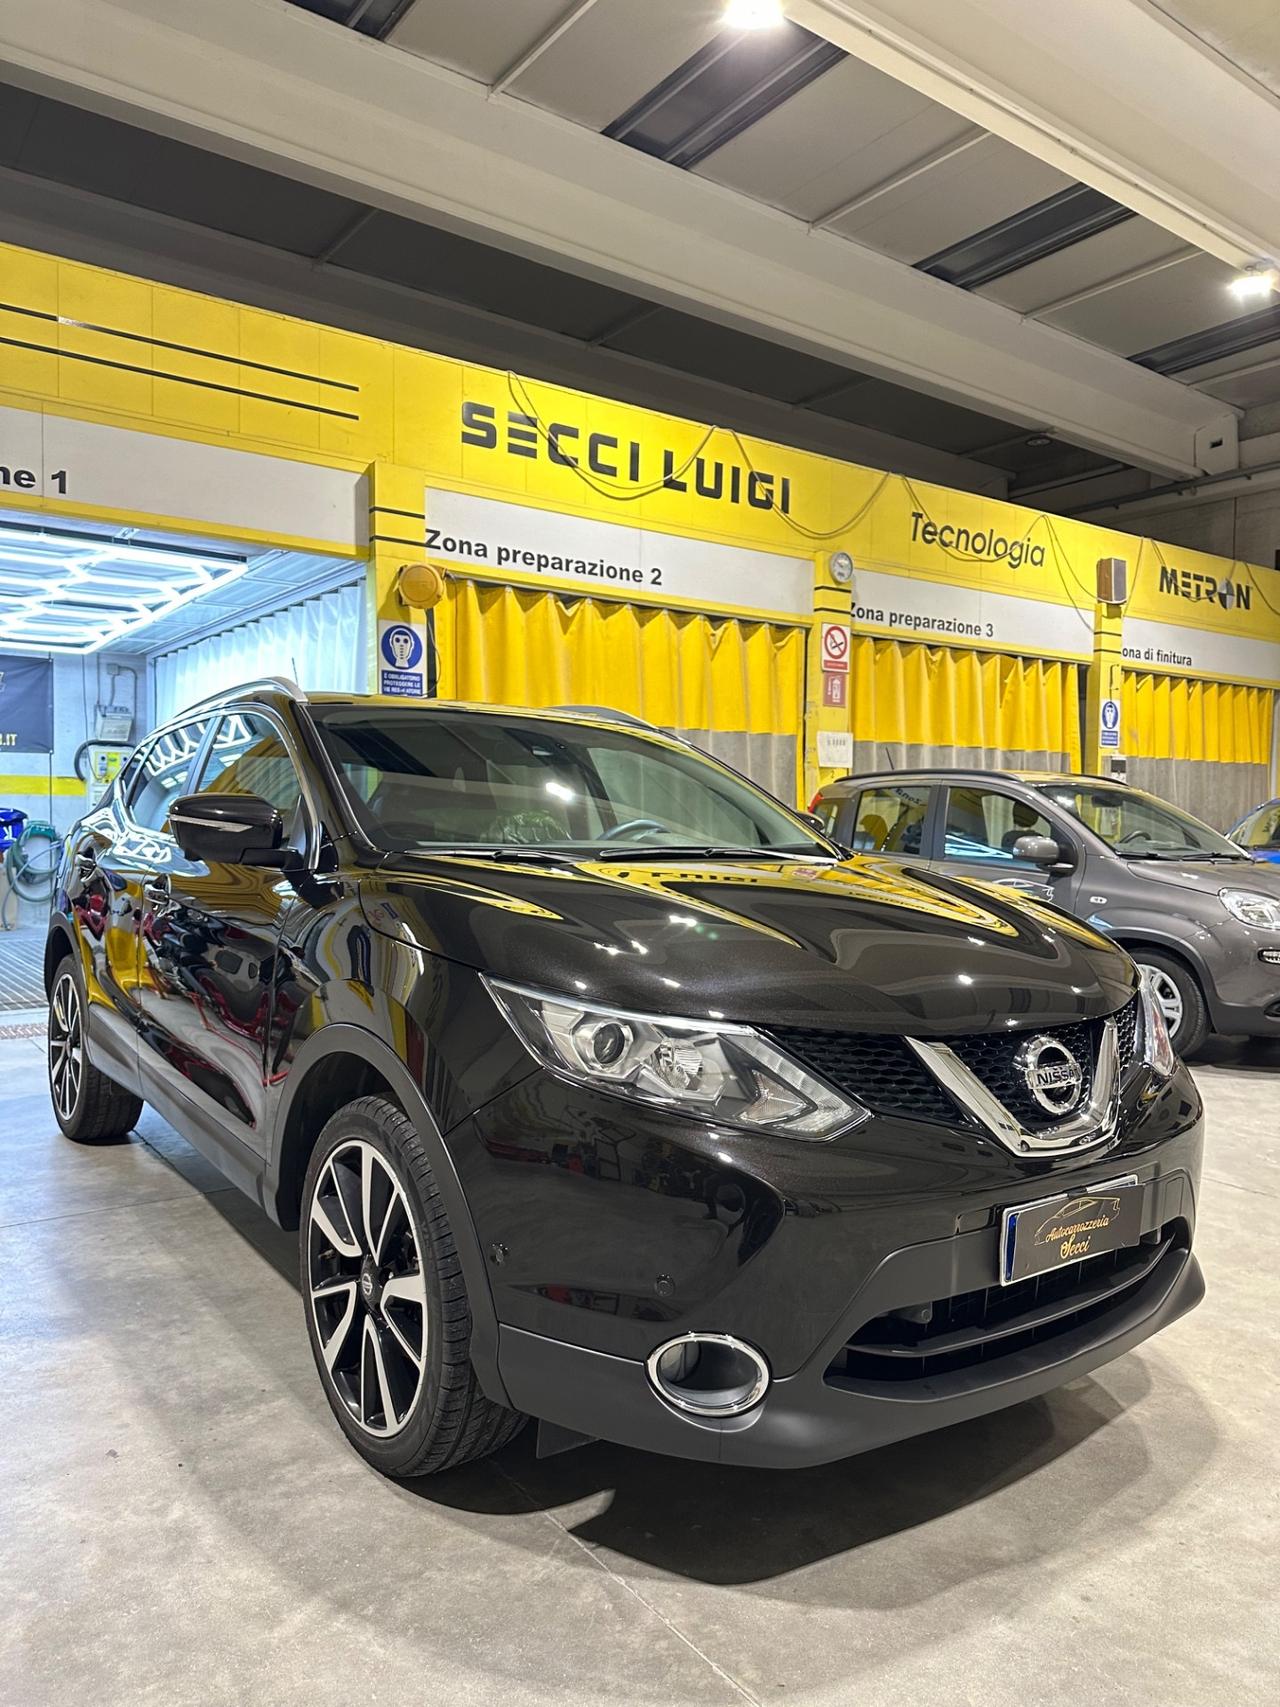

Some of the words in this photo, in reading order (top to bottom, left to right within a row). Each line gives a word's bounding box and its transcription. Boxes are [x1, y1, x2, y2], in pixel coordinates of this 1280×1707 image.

[461, 401, 639, 482] SECCI
[663, 449, 790, 514] LUIGI
[51, 470, 66, 494] 1
[911, 511, 1045, 569] Tecnologia
[425, 528, 488, 558] Zona
[497, 545, 644, 583] preparazione
[650, 567, 662, 586] 2
[889, 611, 982, 636] preparazione
[986, 623, 994, 637] 3
[1122, 647, 1141, 659] ona
[1144, 648, 1154, 661] di
[1156, 649, 1192, 666] finitura
[0, 733, 17, 746] .IT
[1037, 1067, 1078, 1084] NISSA
[1060, 1234, 1091, 1260] Secci
